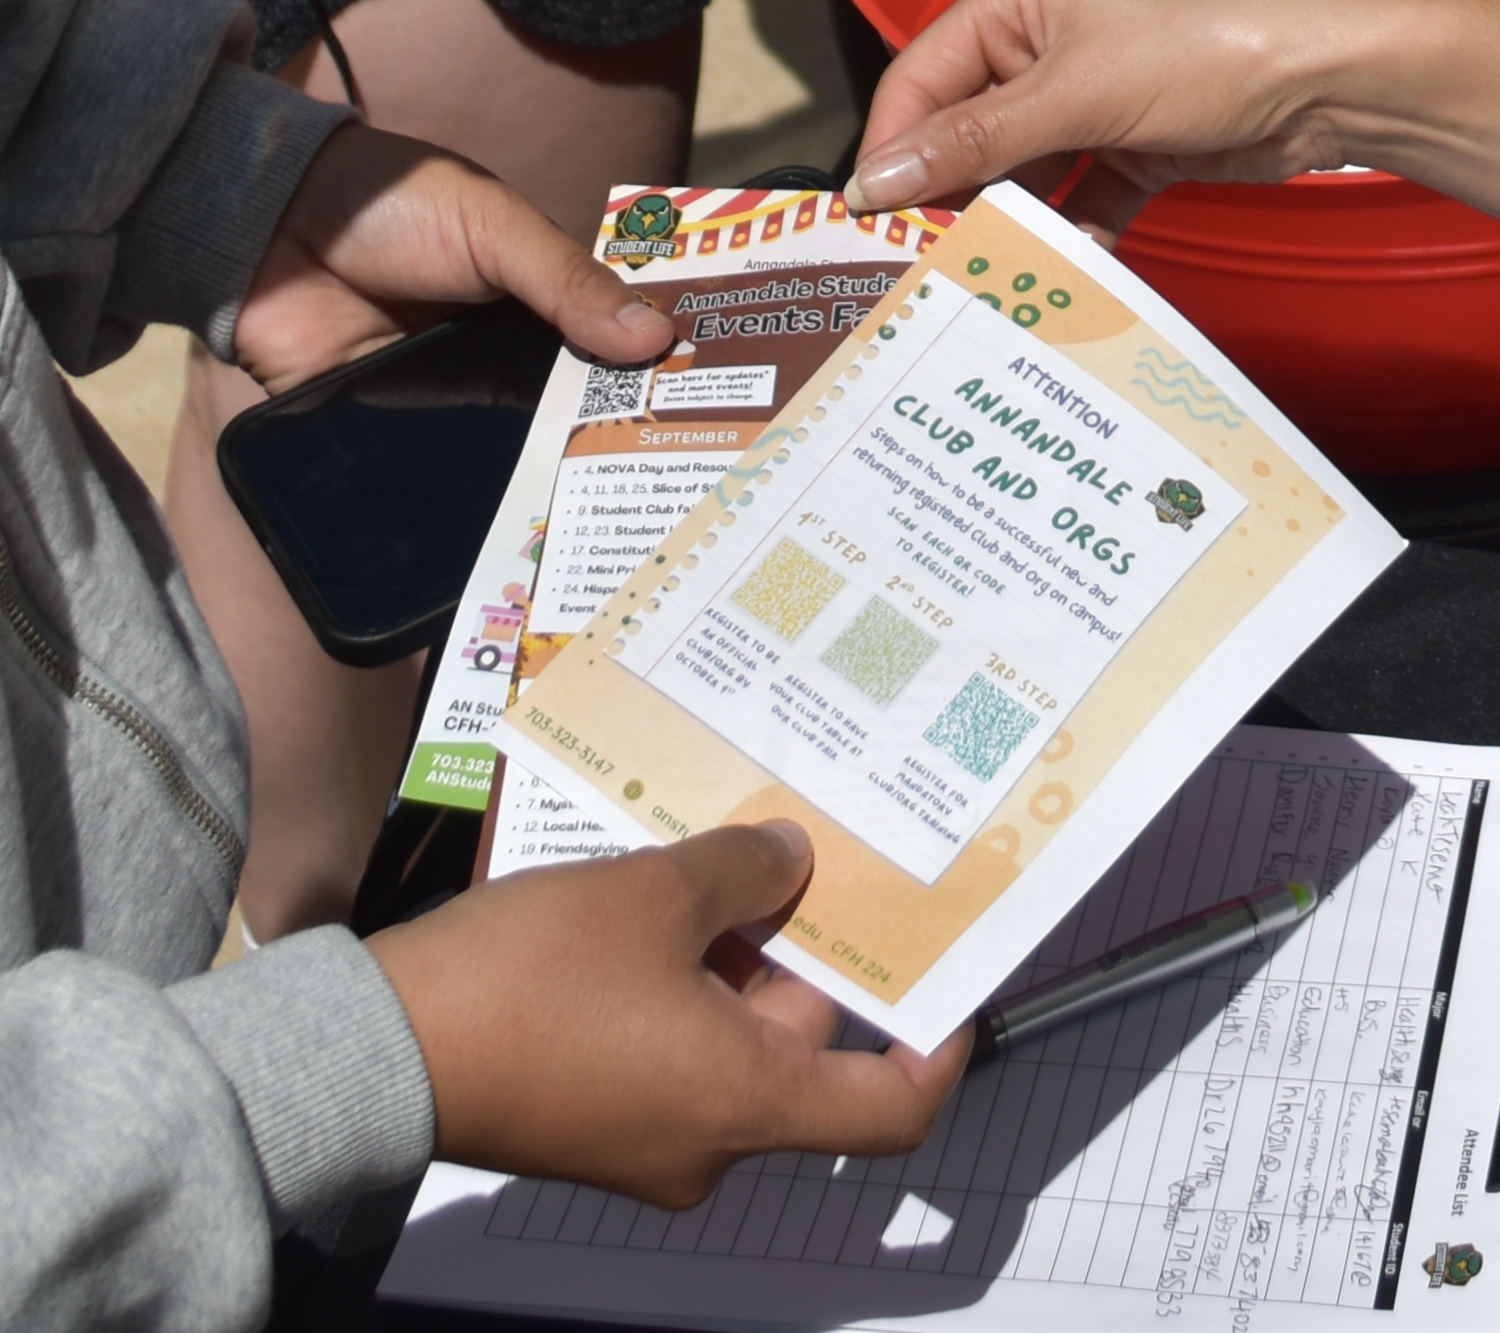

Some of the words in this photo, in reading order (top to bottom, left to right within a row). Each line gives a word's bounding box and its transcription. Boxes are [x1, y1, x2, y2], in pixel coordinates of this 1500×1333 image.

[606, 239, 651, 257] STUDENT
[653, 241, 676, 259] LIFE
[673, 277, 812, 316] Annandale
[818, 272, 900, 299] Stude
[692, 305, 822, 342] Events
[656, 375, 679, 386] Scan
[681, 373, 703, 383] here
[705, 372, 722, 382] for
[667, 383, 686, 393] and
[688, 383, 713, 392] more
[716, 381, 753, 392] events!
[1007, 356, 1119, 440] ATTENTION
[953, 377, 1134, 506] ANNANDALE
[597, 463, 636, 475] NOVA
[638, 462, 664, 477] Day
[666, 462, 691, 474] and
[652, 482, 682, 494] Slice
[684, 482, 699, 494] of
[893, 395, 975, 454] CLUB
[972, 455, 1038, 501] AND
[1050, 506, 1136, 575] ORGS
[591, 504, 642, 516] Student
[645, 503, 674, 515] Club
[614, 524, 666, 536] Student
[870, 426, 907, 458] Steps
[905, 451, 924, 468] on
[925, 462, 950, 488] how
[951, 482, 967, 500] to
[965, 491, 985, 514] be
[994, 515, 1061, 570] successful
[1060, 563, 1088, 589] new
[1088, 582, 1119, 609] and
[821, 530, 868, 565] STEP
[851, 445, 911, 495] returning
[908, 484, 974, 535] registered
[970, 527, 1000, 555] Club
[999, 548, 1028, 575] and
[1049, 588, 1069, 608] on
[1067, 600, 1124, 645] campus!
[886, 506, 920, 533] SCAN
[921, 529, 955, 559] EACH
[953, 553, 973, 573] QR
[973, 567, 1007, 596] CODE
[587, 564, 614, 575] Mini
[895, 536, 914, 555] TO
[911, 550, 978, 600] REGISTER!
[559, 603, 597, 614] Event
[884, 574, 916, 594] 2ND
[911, 595, 955, 629] STEP
[685, 637, 736, 679] CLUB/ORG
[700, 626, 716, 641] AN
[715, 636, 759, 672] OFFICIAL
[704, 607, 750, 643] REGISTER
[750, 638, 766, 654] TO
[765, 648, 782, 666] BE
[675, 651, 719, 688] OCTOBER
[985, 652, 1017, 682] 3RD
[1017, 678, 1059, 712] STEP
[448, 698, 473, 714] AN
[769, 681, 794, 705] YOUR
[794, 701, 821, 724] CLUB
[819, 719, 852, 749] TABLE
[848, 743, 865, 759] AT
[784, 673, 830, 711] REGISTER
[829, 706, 845, 720] TO
[842, 715, 870, 741] HAVE
[523, 705, 617, 777] 703-323-3147
[770, 704, 791, 725] OUR
[791, 720, 818, 744] CLUB
[815, 739, 840, 762] FAIR
[894, 770, 954, 817] MANDATORY
[902, 755, 950, 794] REGISTER
[948, 788, 970, 809] FOR
[1471, 779, 1487, 805] Name
[542, 820, 579, 834] Local
[868, 770, 917, 813] CLUB/ORG
[917, 808, 962, 846] TRAINING
[539, 842, 631, 856] Friendsgiving
[830, 939, 866, 968] CFH
[862, 960, 893, 985] 224
[1286, 985, 1323, 1067] Education
[1431, 990, 1447, 1020] Major
[1415, 1089, 1430, 1118] Email
[1455, 1127, 1481, 1192] Attendee
[1450, 1193, 1465, 1217] List
[1387, 1222, 1405, 1261] Student
